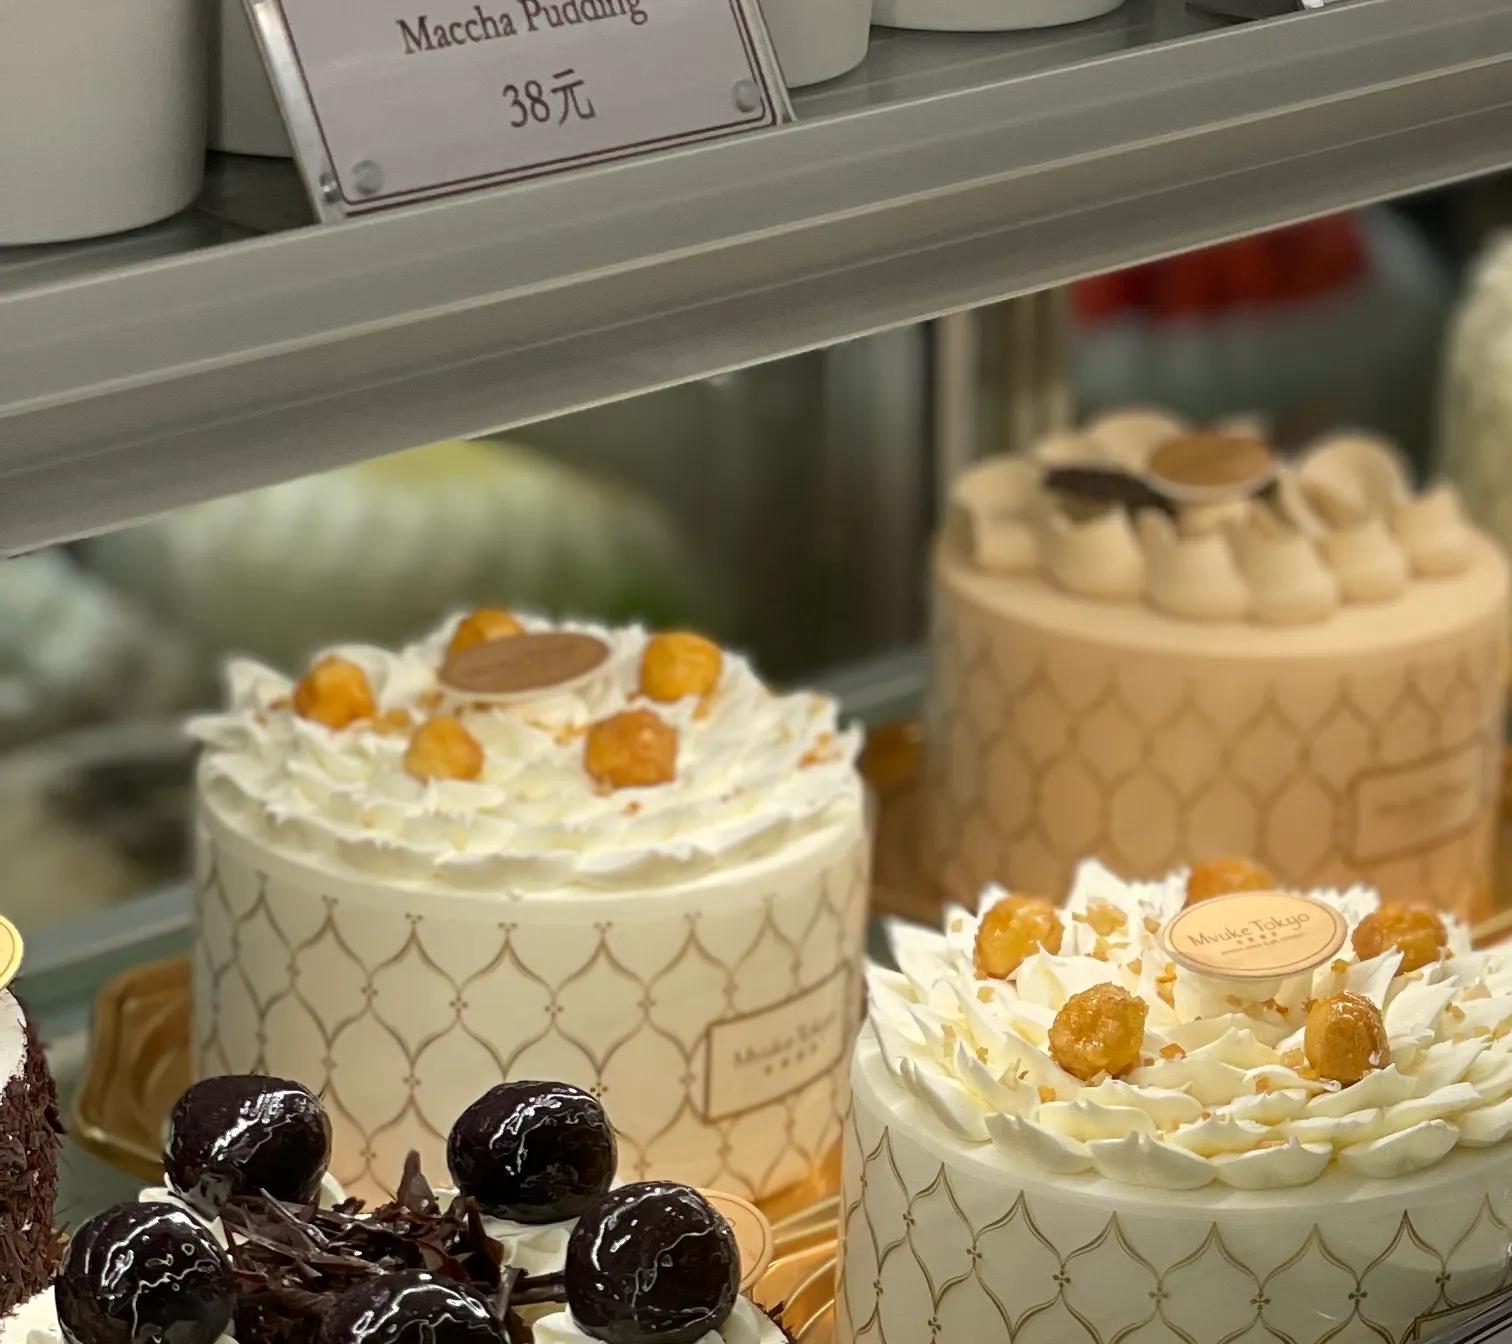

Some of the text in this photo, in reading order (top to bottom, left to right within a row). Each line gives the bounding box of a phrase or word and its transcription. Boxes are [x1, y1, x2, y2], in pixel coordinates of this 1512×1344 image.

[396, 4, 517, 55] Maccha
[502, 68, 595, 128] 38元
[1188, 926, 1252, 946] Mvuke
[1248, 913, 1310, 931] Tokyo
